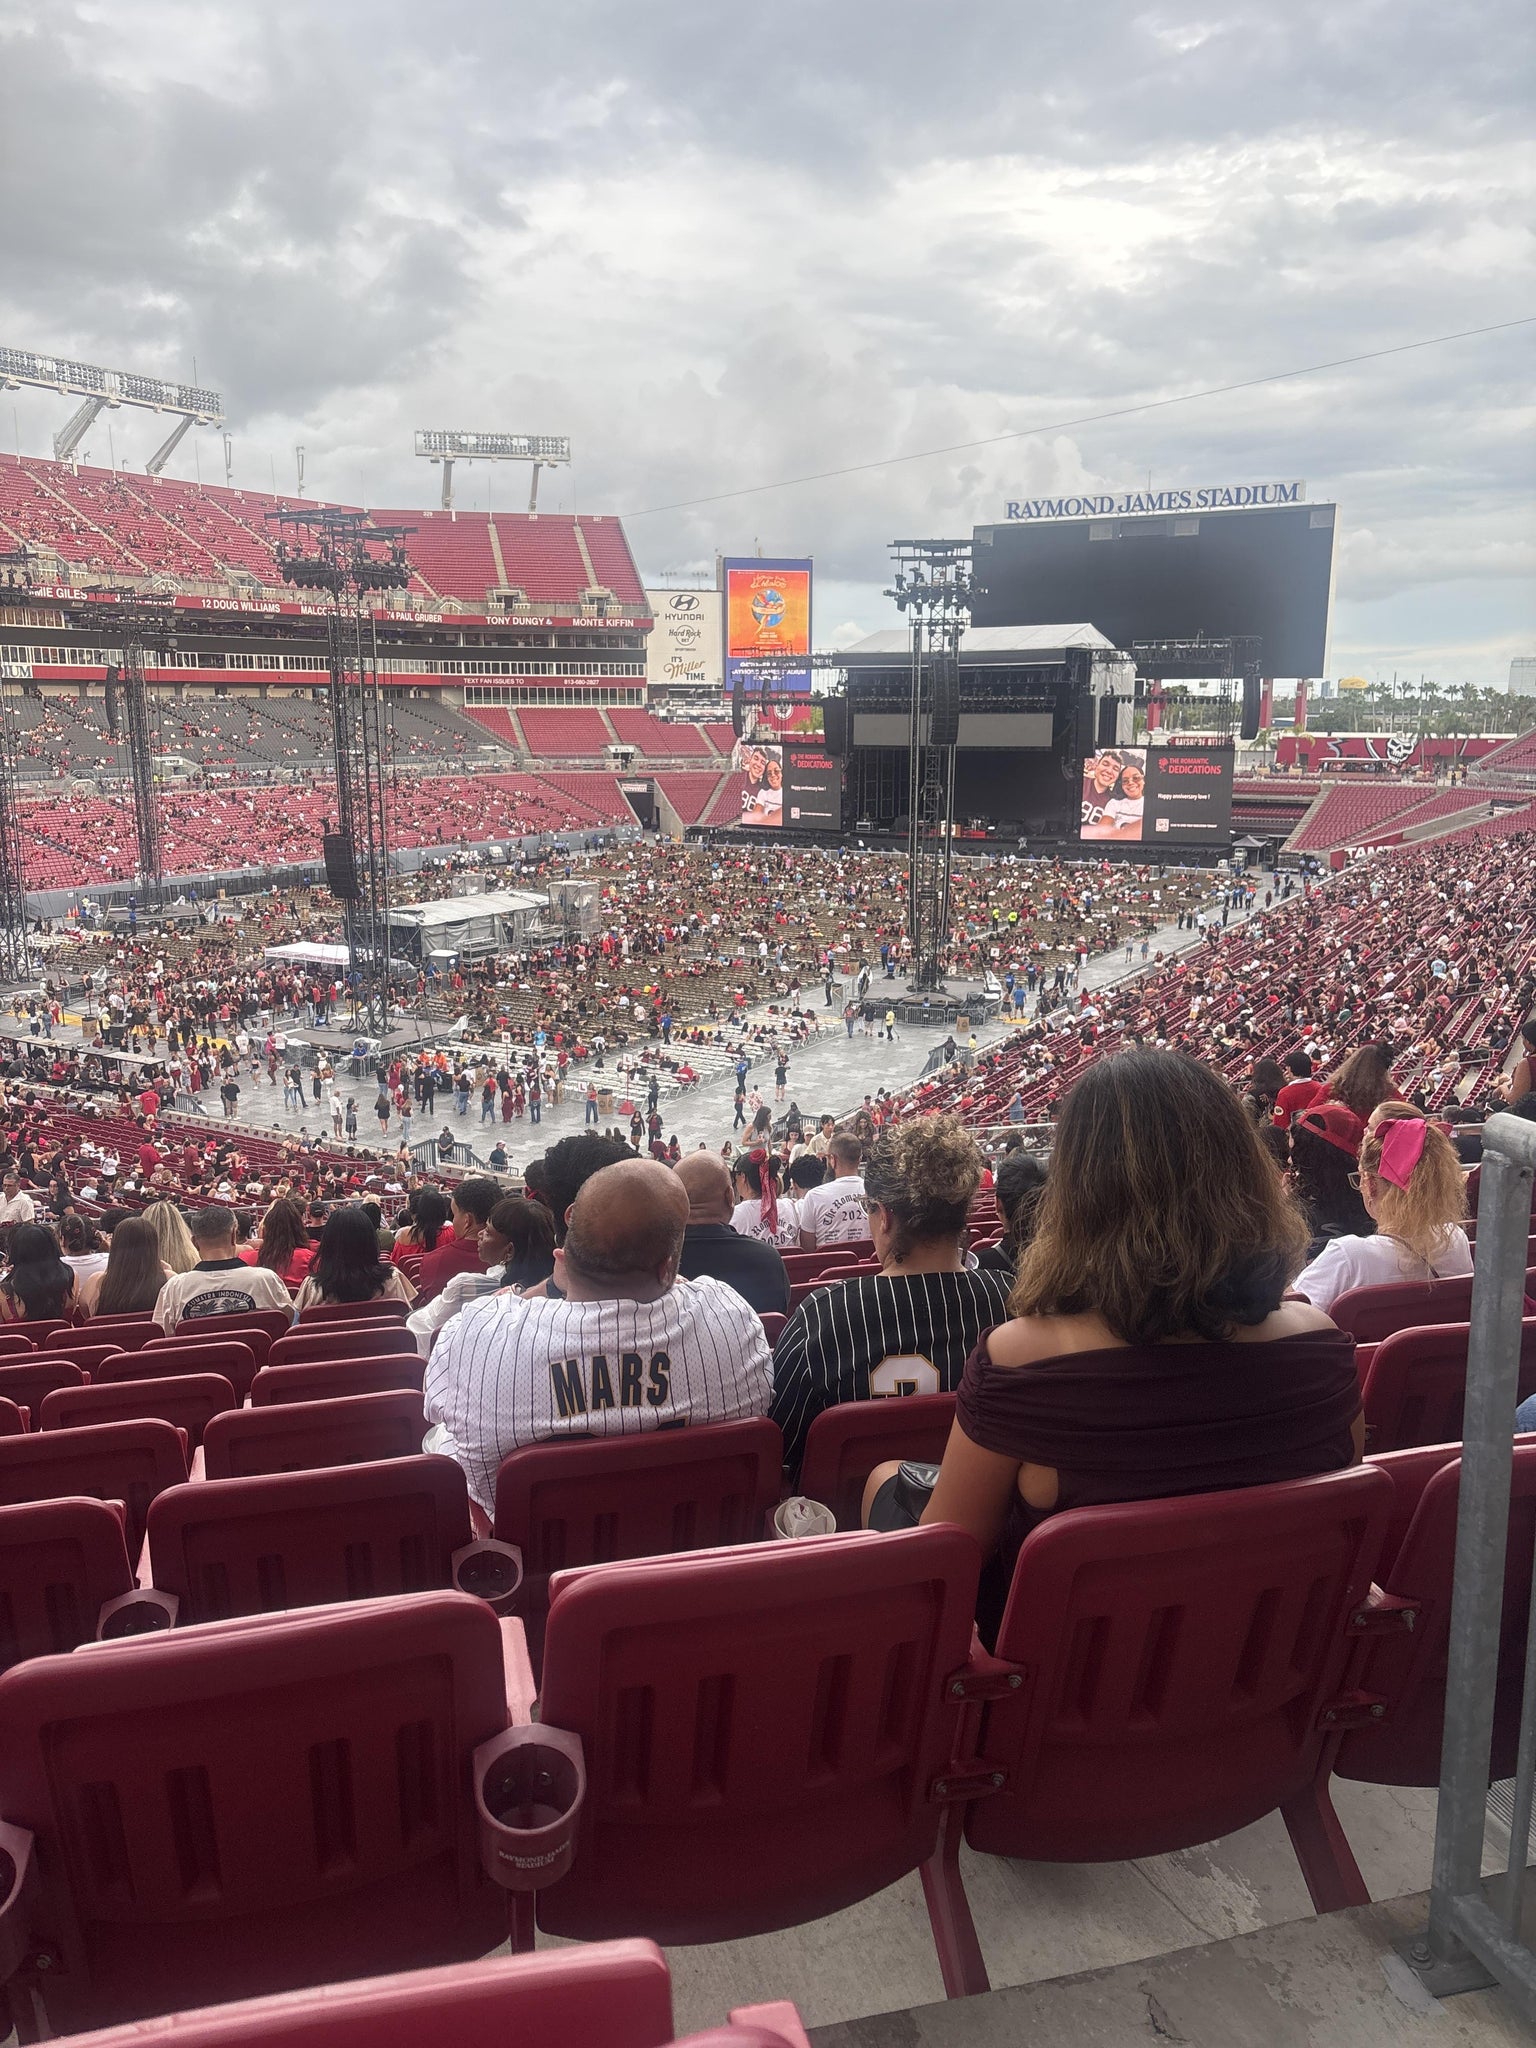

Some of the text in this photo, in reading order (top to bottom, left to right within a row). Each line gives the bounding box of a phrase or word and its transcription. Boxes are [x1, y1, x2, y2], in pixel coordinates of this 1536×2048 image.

[1007, 482, 1300, 520] RAYMOND JAMES STADIUM
[56, 588, 88, 600] GILES
[201, 598, 281, 614] 12 DOUG WILLIAMS
[387, 611, 442, 623] 74 PAUL GRUBER
[486, 616, 545, 626] TONY DUNGY
[572, 618, 634, 627] MONTE KIFFIN
[665, 613, 705, 621] HYUNDAI
[669, 629, 702, 638] Hard Rock
[663, 660, 706, 680] Miller
[686, 673, 706, 681] TIME
[797, 760, 833, 769] DEDICATIONS
[1168, 765, 1222, 774] DEDICATIONS
[822, 1208, 837, 1226] The
[187, 1290, 252, 1308] SUMATRA INDONESIA
[550, 1351, 671, 1418] MARS
